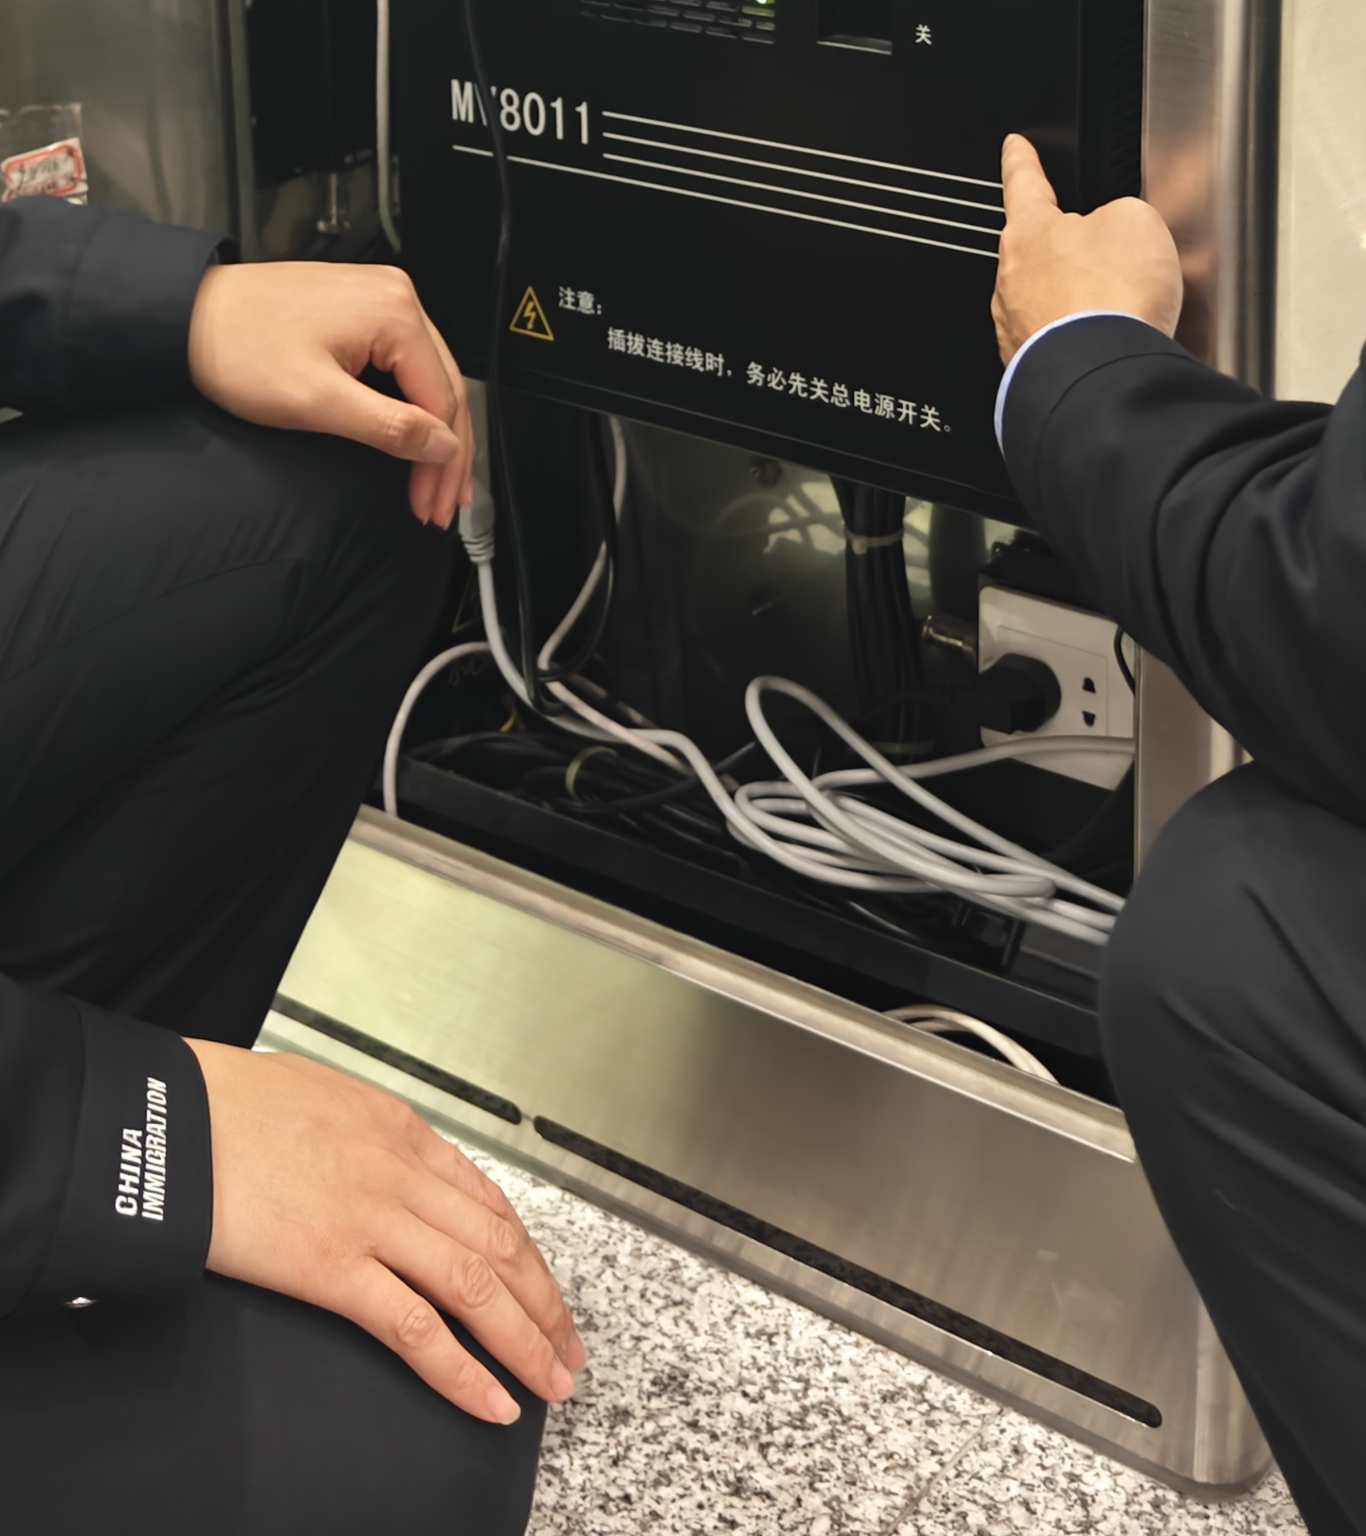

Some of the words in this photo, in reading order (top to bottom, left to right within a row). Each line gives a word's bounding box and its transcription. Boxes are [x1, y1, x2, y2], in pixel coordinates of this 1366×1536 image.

[915, 24, 932, 45] 关
[115, 1127, 143, 1217] CHINA
[141, 1076, 168, 1222] IMMIGRATION
